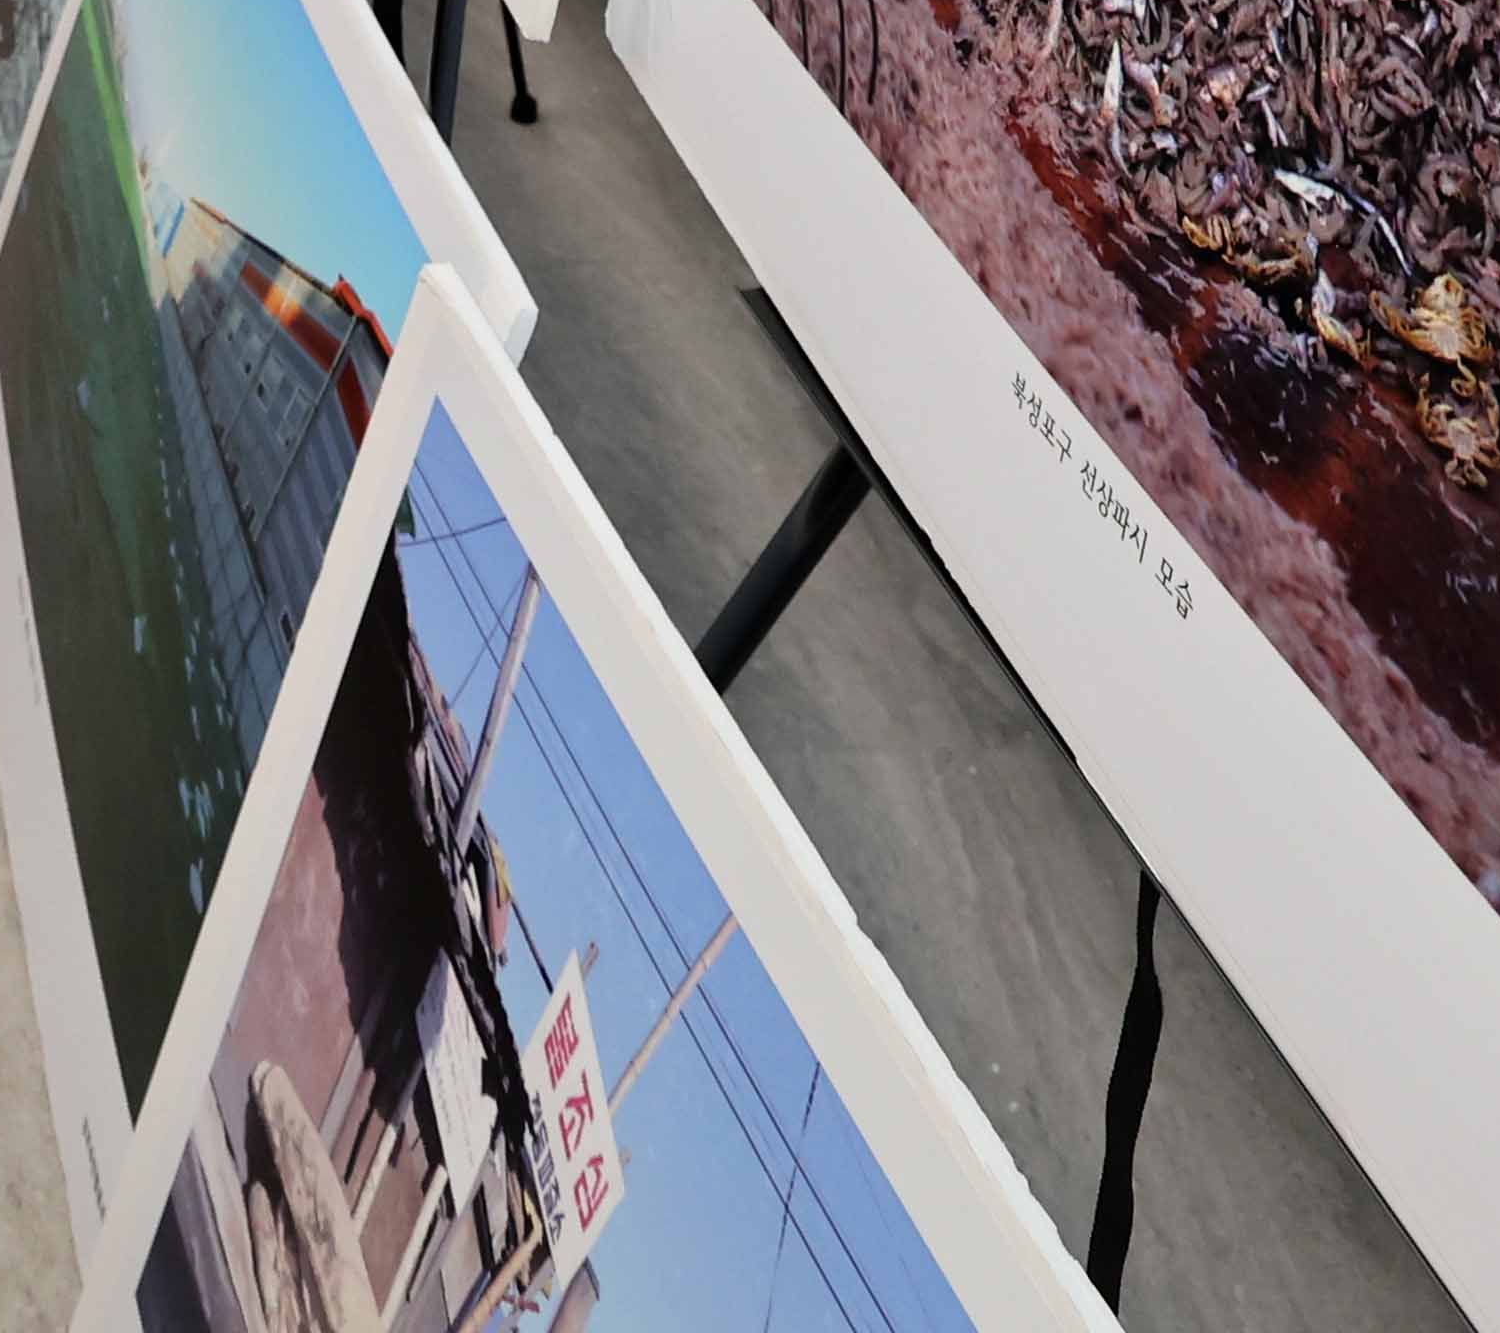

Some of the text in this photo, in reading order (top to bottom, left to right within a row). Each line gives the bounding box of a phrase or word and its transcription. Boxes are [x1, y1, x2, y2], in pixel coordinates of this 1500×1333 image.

[1010, 371, 1195, 620] 북성포구 선상파시 모습
